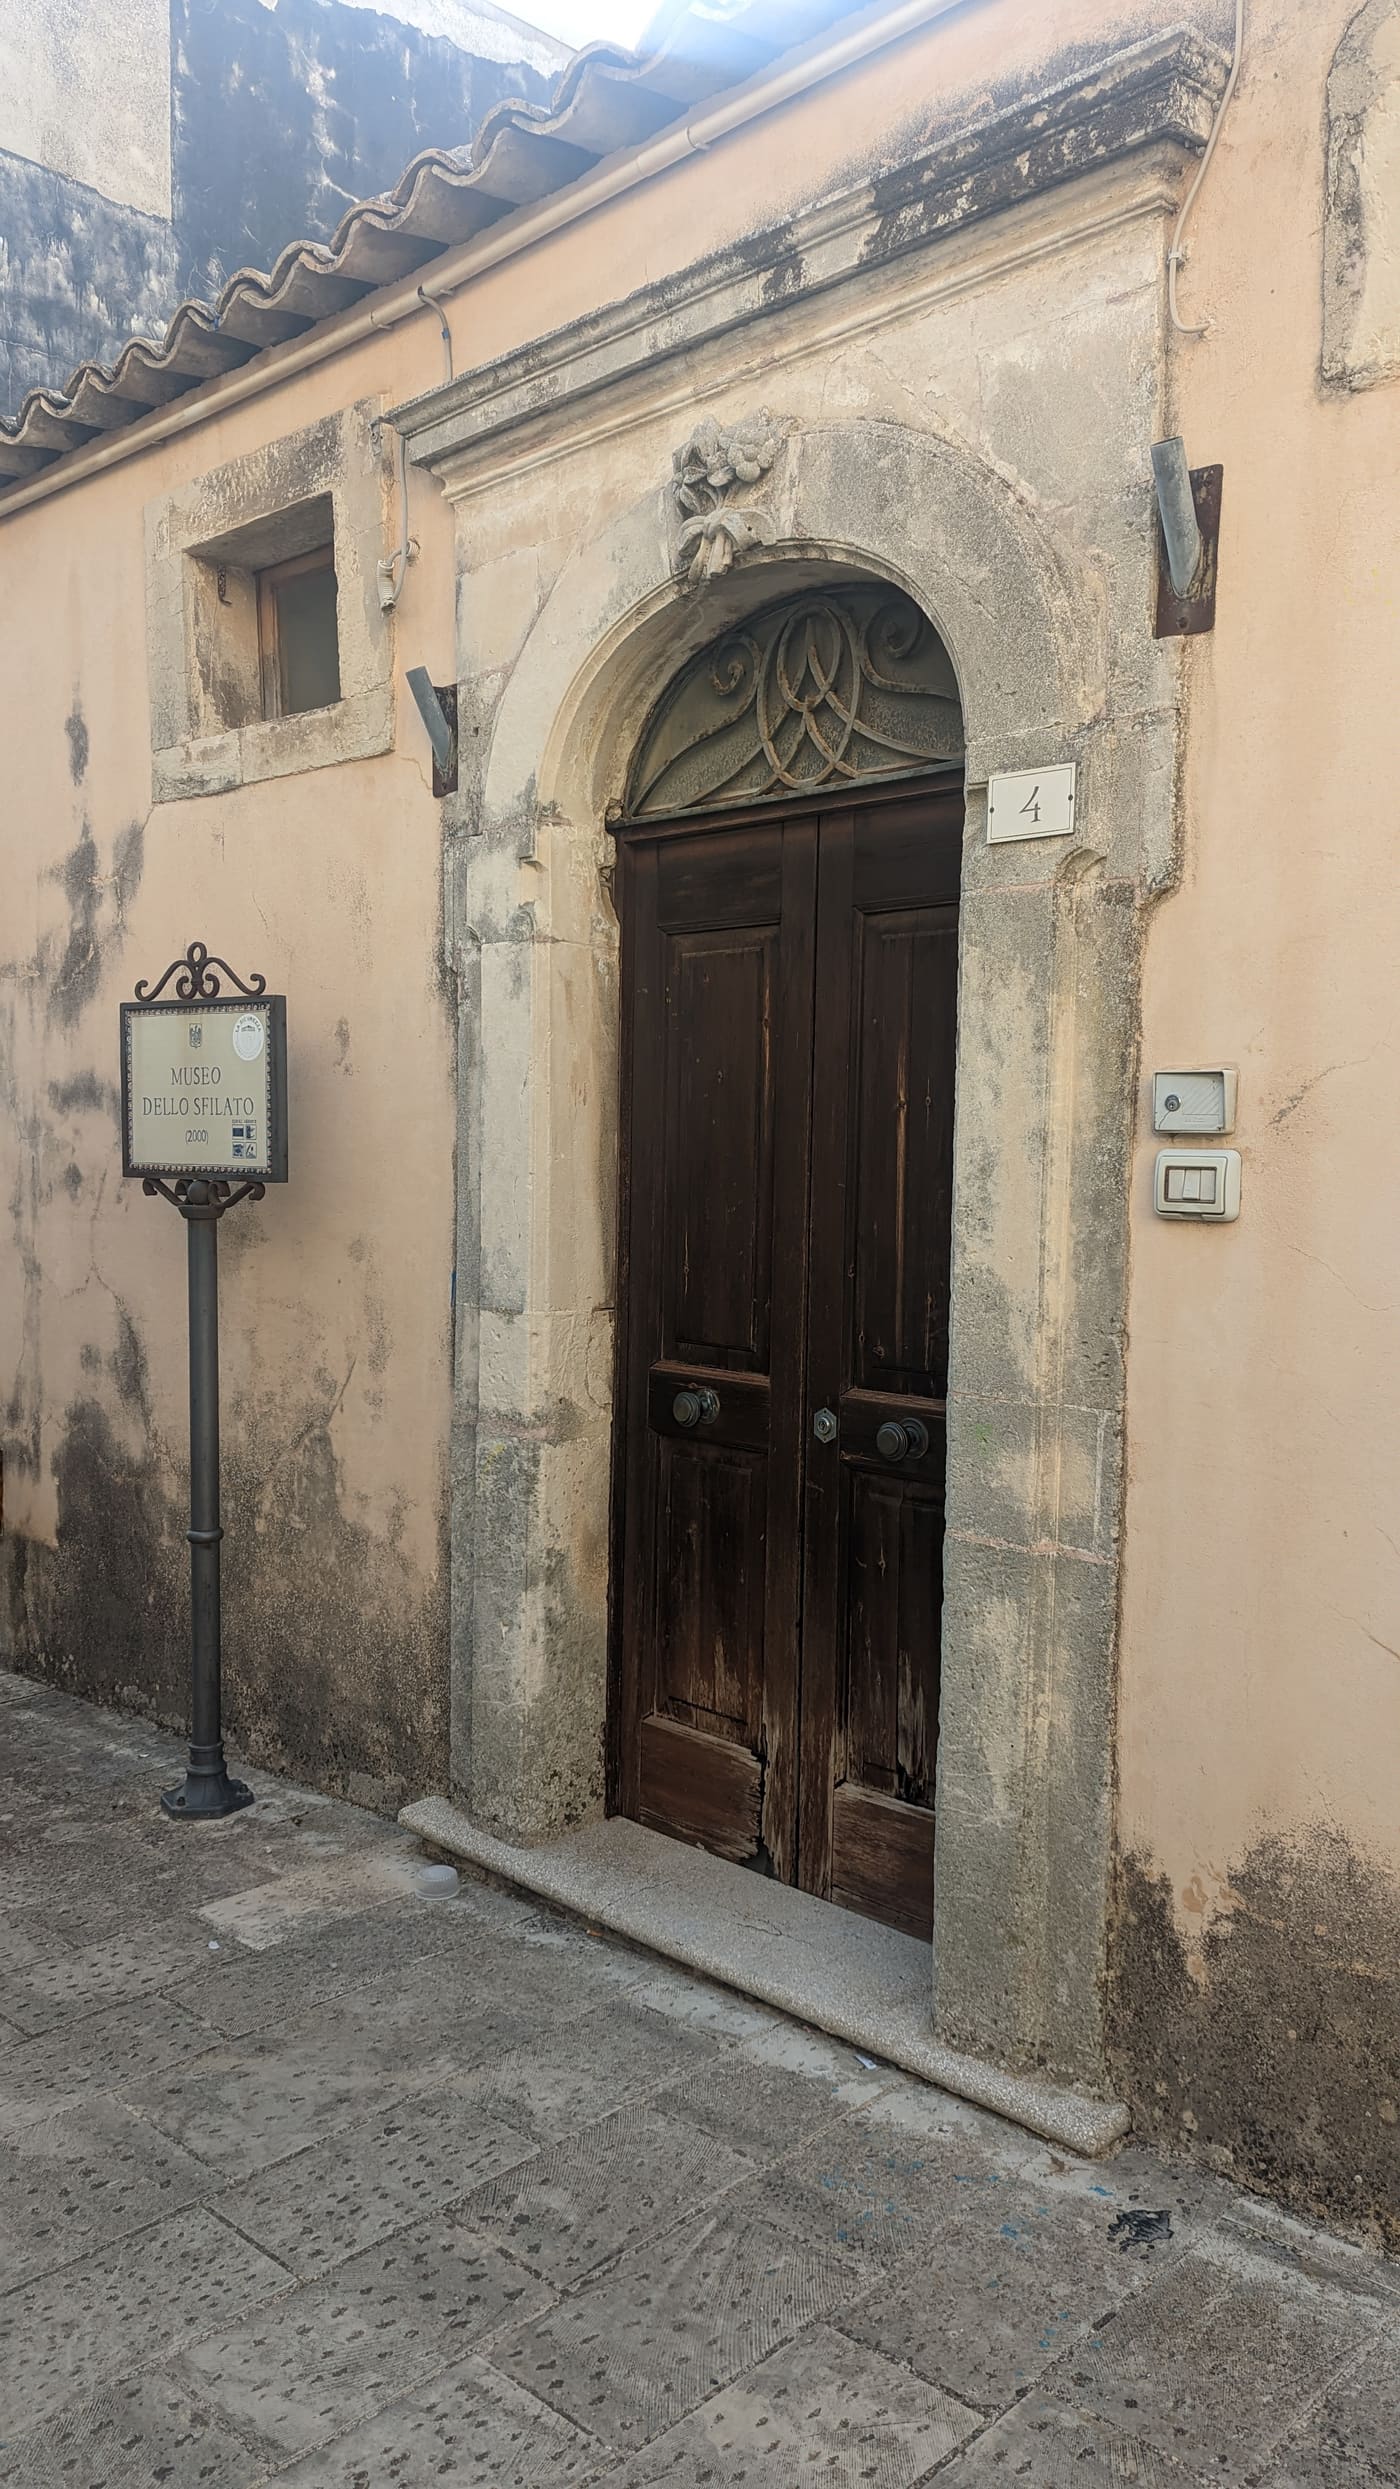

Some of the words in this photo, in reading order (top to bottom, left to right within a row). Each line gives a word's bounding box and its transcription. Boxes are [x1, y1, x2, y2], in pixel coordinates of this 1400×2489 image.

[1019, 785, 1041, 823] 4
[171, 1066, 221, 1086] MUSEO
[143, 1097, 188, 1116] DELLO
[193, 1097, 254, 1116] SFILATO
[185, 1129, 209, 1144] (2000)
